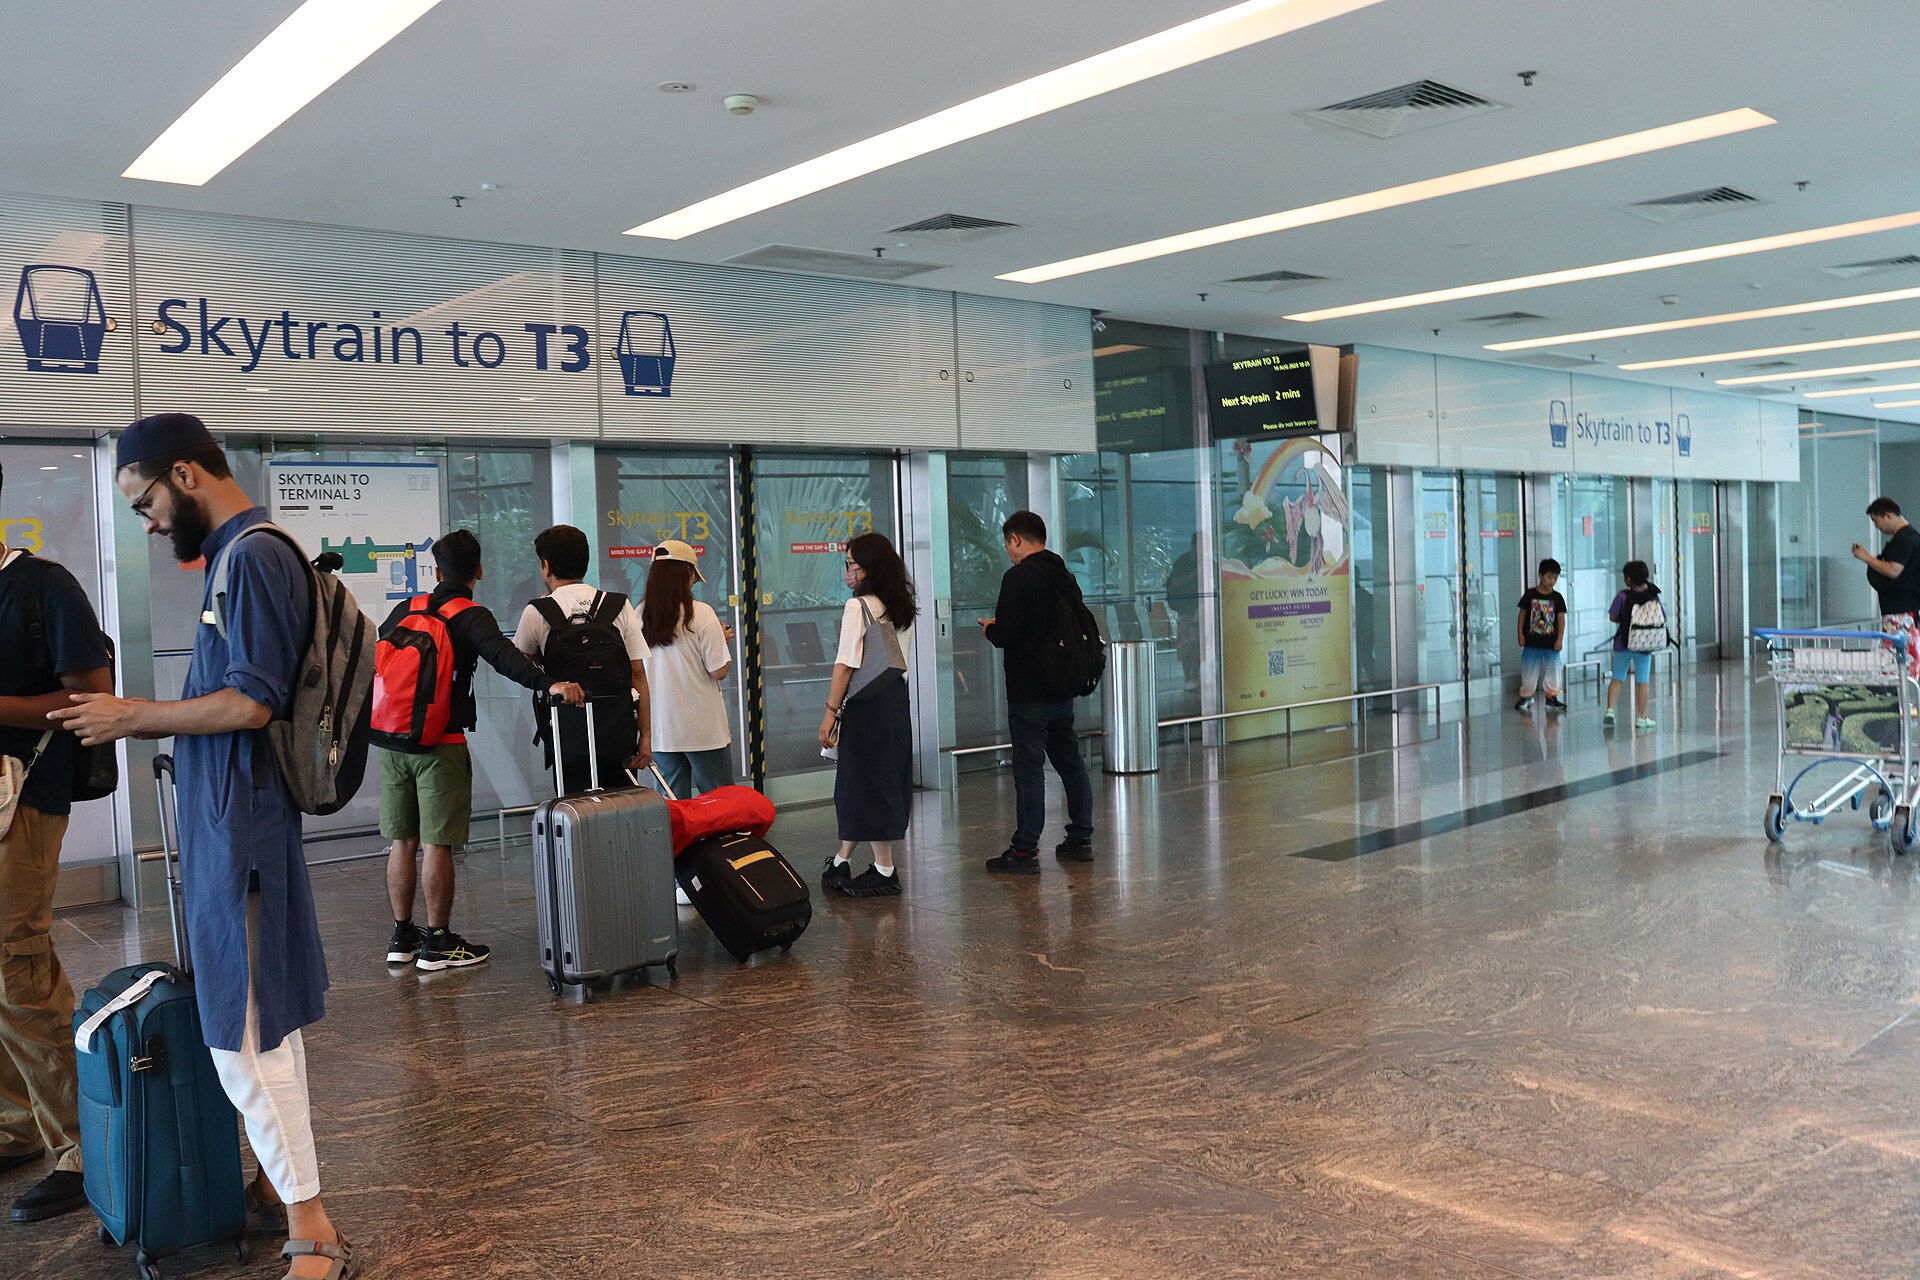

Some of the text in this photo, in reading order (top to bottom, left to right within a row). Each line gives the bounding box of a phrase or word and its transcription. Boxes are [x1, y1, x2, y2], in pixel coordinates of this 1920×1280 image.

[158, 297, 591, 373] Skytrain to T3
[1232, 355, 1280, 370] SKYTRAIN TO T3
[1221, 388, 1301, 408] Next Skytrain 2 mins
[1278, 421, 1285, 429] do
[1576, 412, 1670, 446] Skytrain to T3
[278, 473, 370, 486] SKYTRAIN TO
[279, 488, 361, 500] TERMINAL 3
[607, 510, 710, 540] Skytrain T3
[842, 511, 873, 538] T3
[655, 527, 673, 541] to
[419, 565, 433, 576] T1
[1250, 590, 1264, 601] GET
[1289, 588, 1305, 598] WIN
